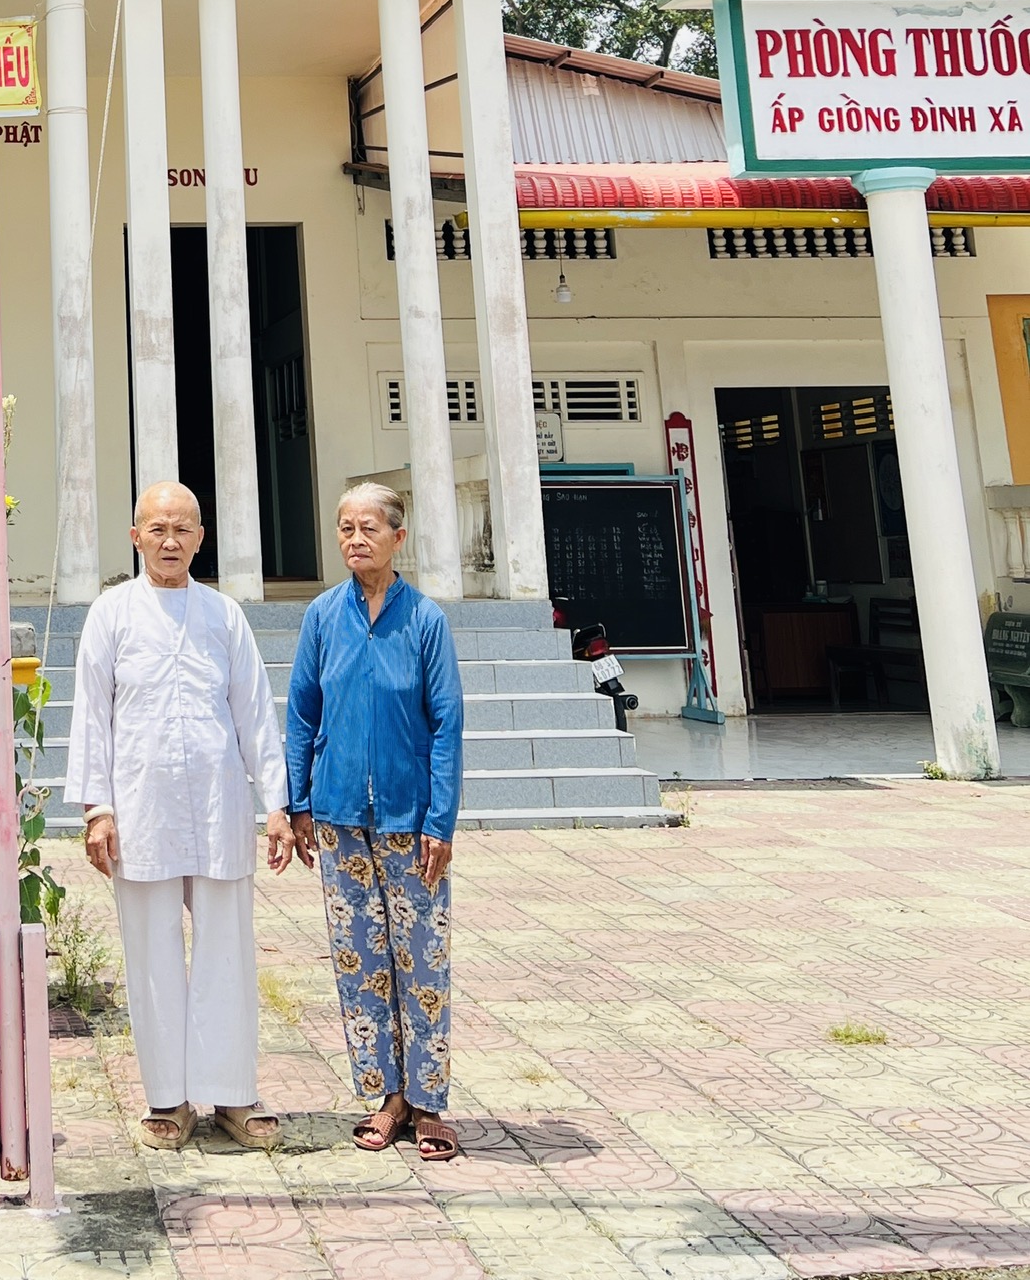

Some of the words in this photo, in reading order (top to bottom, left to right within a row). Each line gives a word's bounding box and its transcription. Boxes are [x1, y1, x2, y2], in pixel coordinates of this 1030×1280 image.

[755, 18, 897, 78] PHÒNG
[771, 92, 805, 133] ẤP
[818, 93, 901, 133] GIỒNG
[910, 97, 977, 133] ĐÌNH
[988, 100, 1023, 132] XÃ
